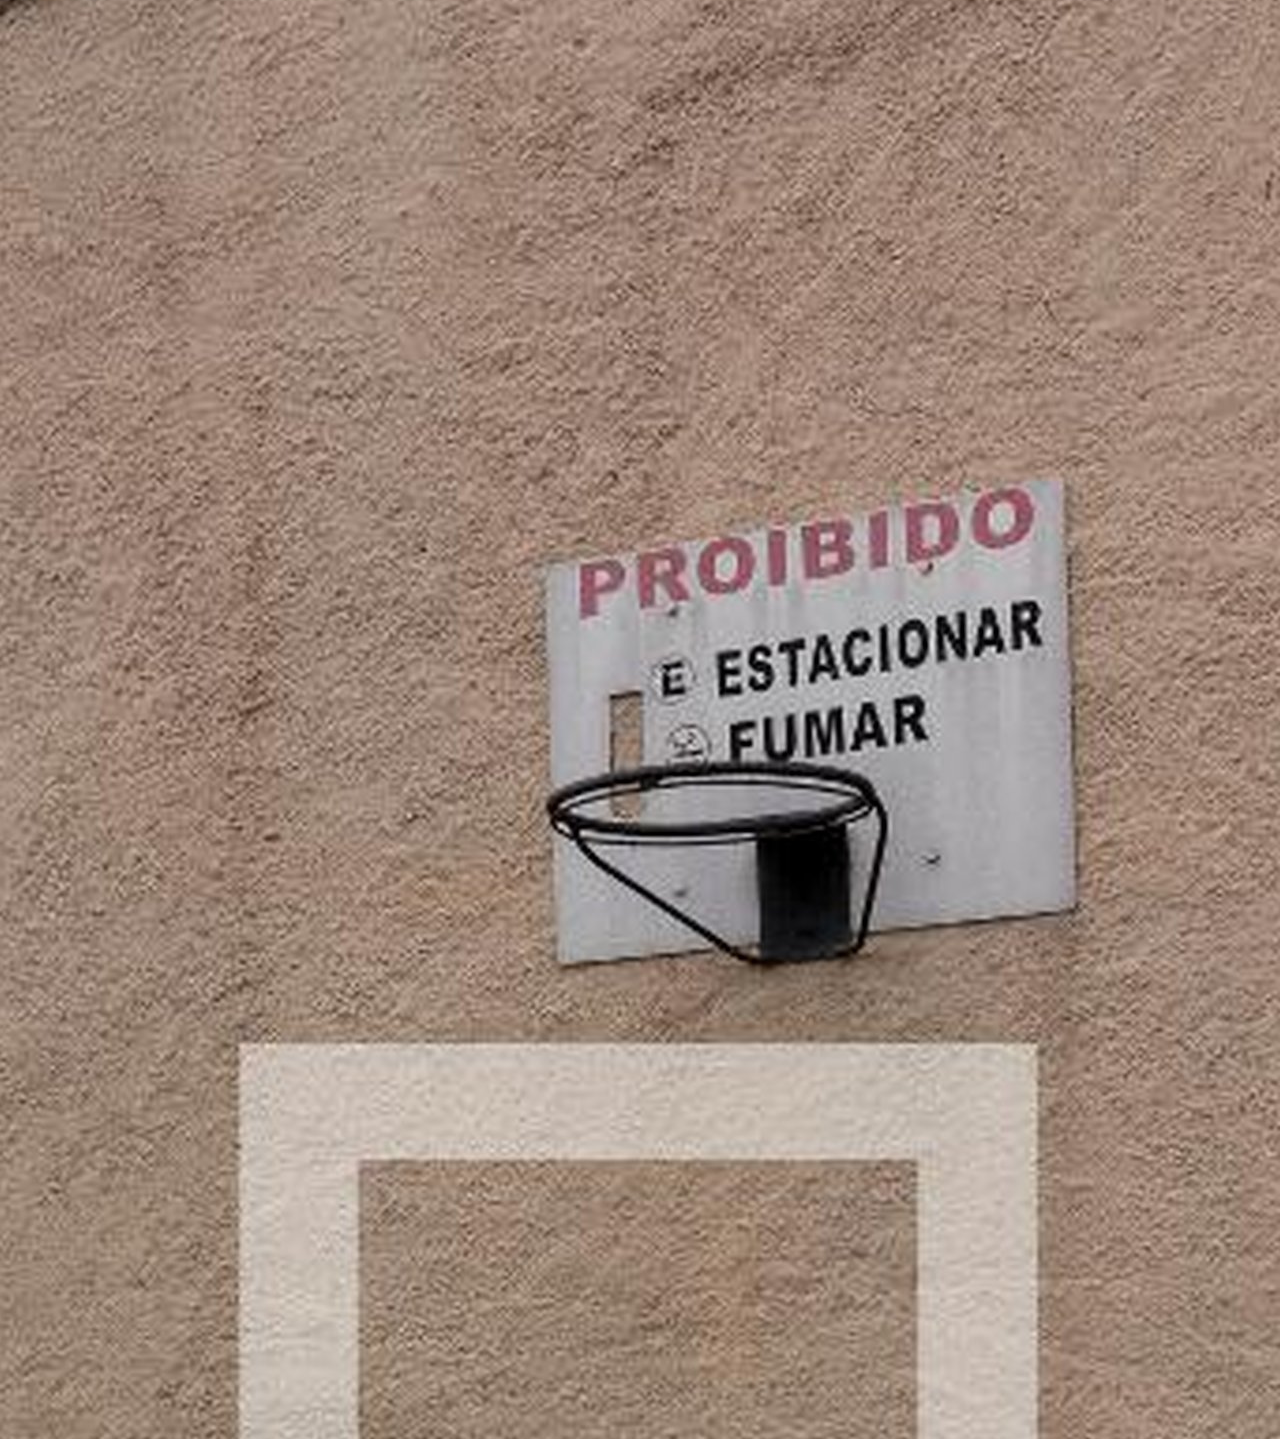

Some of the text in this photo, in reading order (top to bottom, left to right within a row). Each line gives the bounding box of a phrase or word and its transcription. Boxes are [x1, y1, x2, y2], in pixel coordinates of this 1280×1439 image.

[578, 487, 1035, 621] PROIBIDO
[716, 600, 1043, 697] ESTACIONAR
[729, 694, 929, 763] FUMAR
